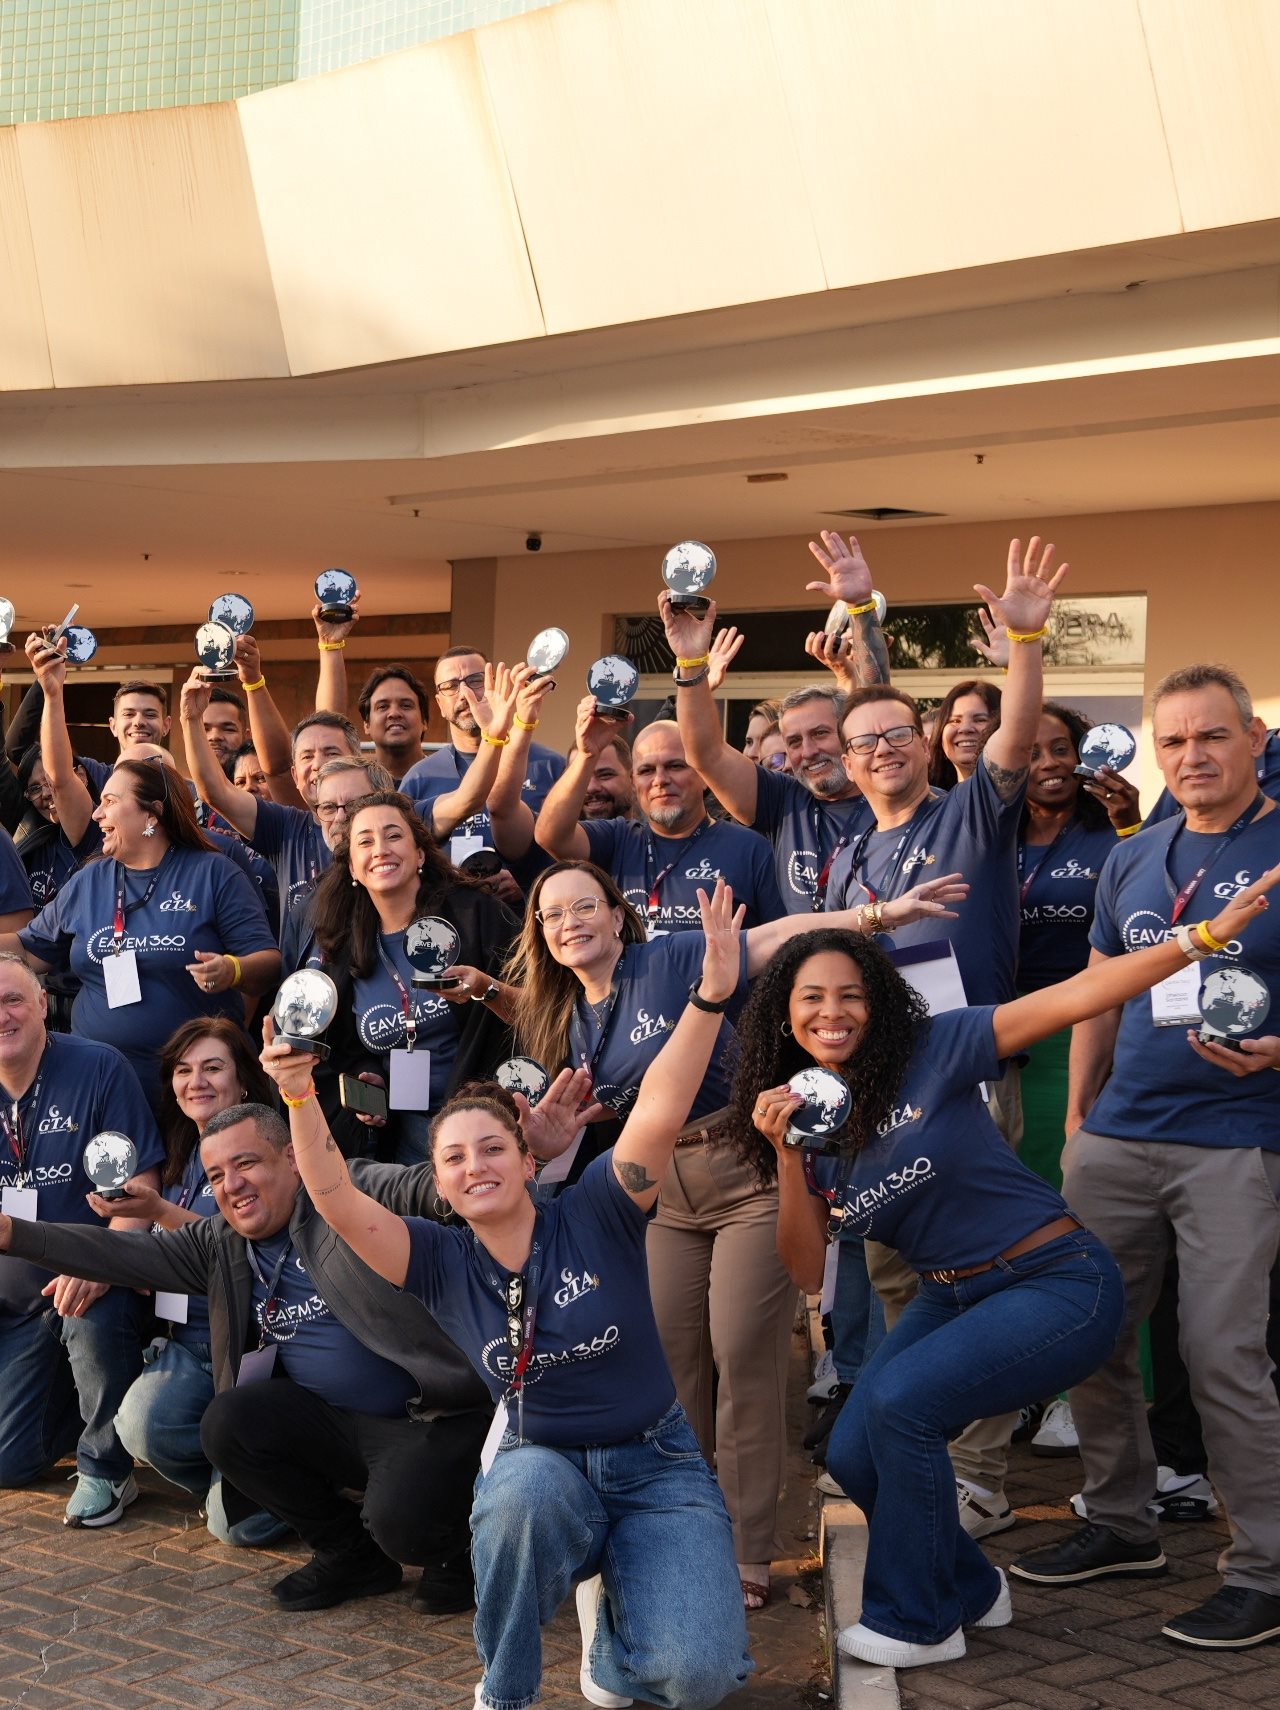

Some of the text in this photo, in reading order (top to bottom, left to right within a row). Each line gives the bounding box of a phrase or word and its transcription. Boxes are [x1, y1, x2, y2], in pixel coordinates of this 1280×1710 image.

[685, 868, 720, 878] GTA
[794, 862, 818, 880] EAV
[1050, 867, 1091, 877] GTA
[160, 900, 191, 910] GTA
[1042, 905, 1087, 918] 360
[98, 935, 186, 949] EAVEM 360
[630, 1014, 667, 1043] GTA
[39, 1116, 73, 1132] GTA
[876, 1103, 914, 1135] GTA
[35, 1163, 73, 1179] 360
[886, 1157, 932, 1189] 360
[554, 1271, 594, 1306] GTA
[570, 1325, 620, 1357] 360
